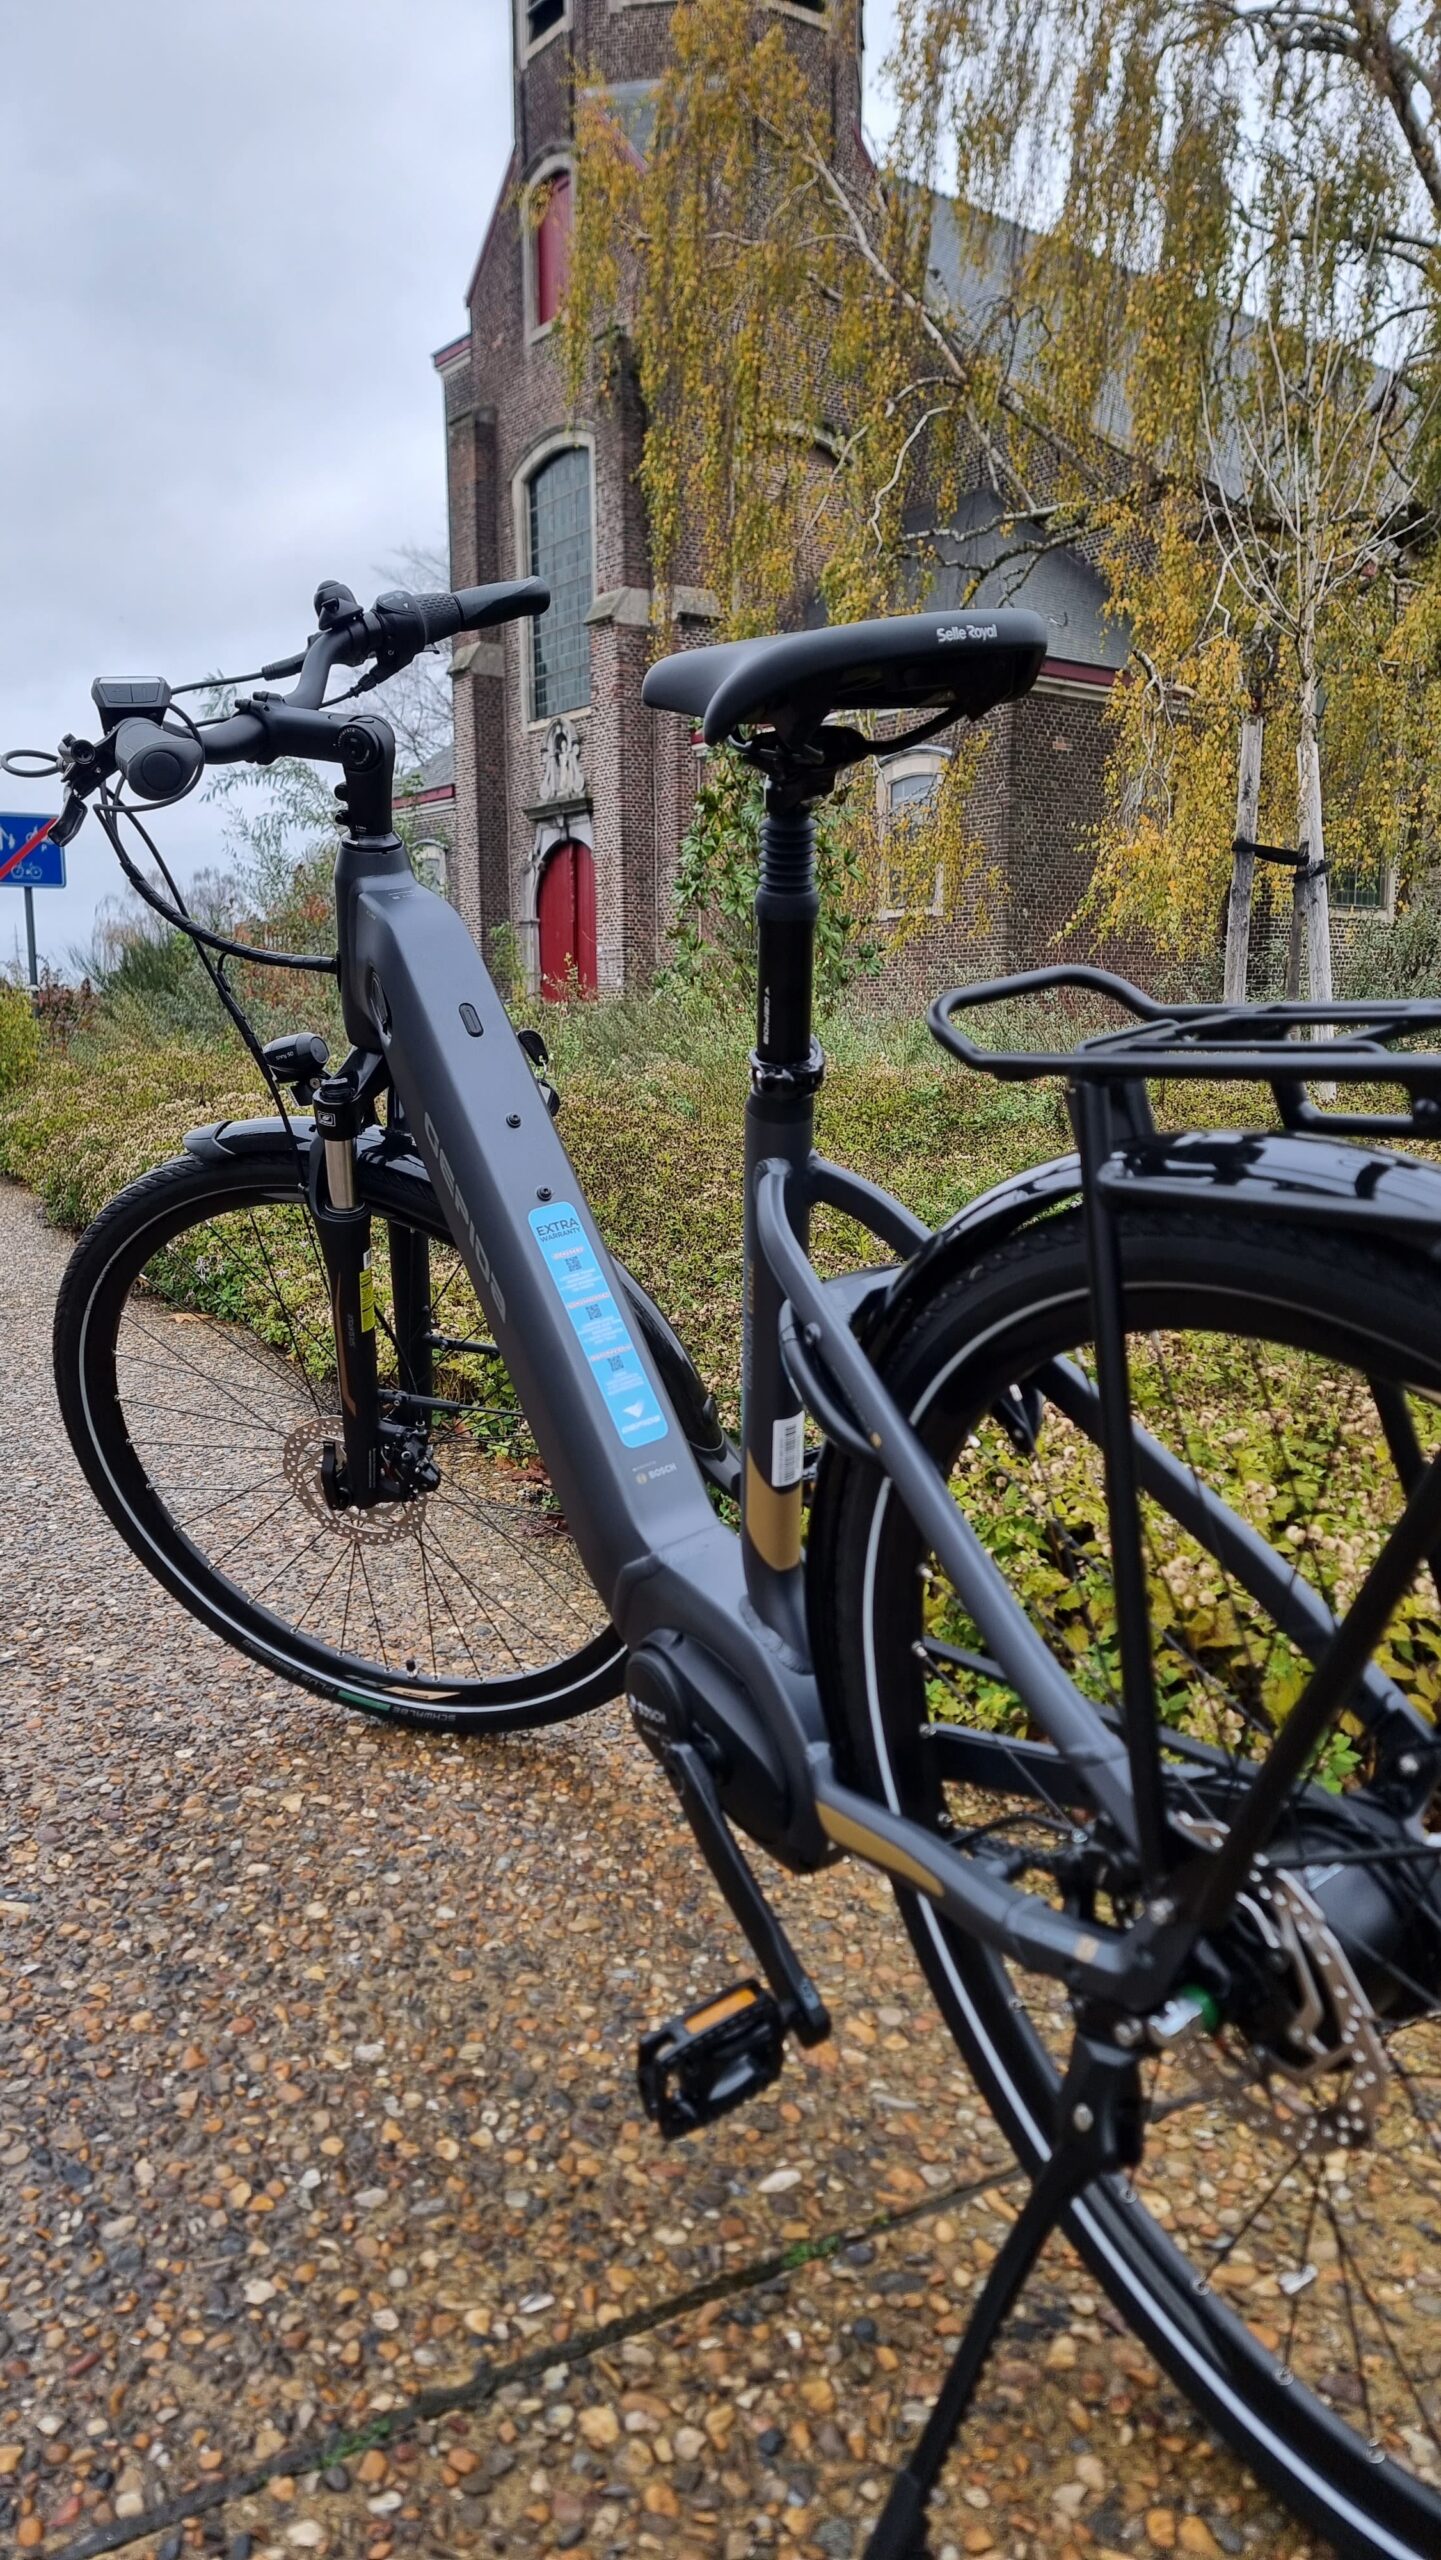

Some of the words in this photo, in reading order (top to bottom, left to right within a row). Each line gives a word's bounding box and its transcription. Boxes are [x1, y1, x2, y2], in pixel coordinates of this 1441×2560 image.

[936, 626, 967, 643] Selle
[966, 623, 998, 642] Royal
[424, 1111, 506, 1323] GEPIDA
[535, 1217, 579, 1237] EXTRA
[540, 1227, 581, 1243] WARRANTY
[648, 1462, 677, 1479] BOSCH
[391, 1705, 457, 1721] SCHWALBE
